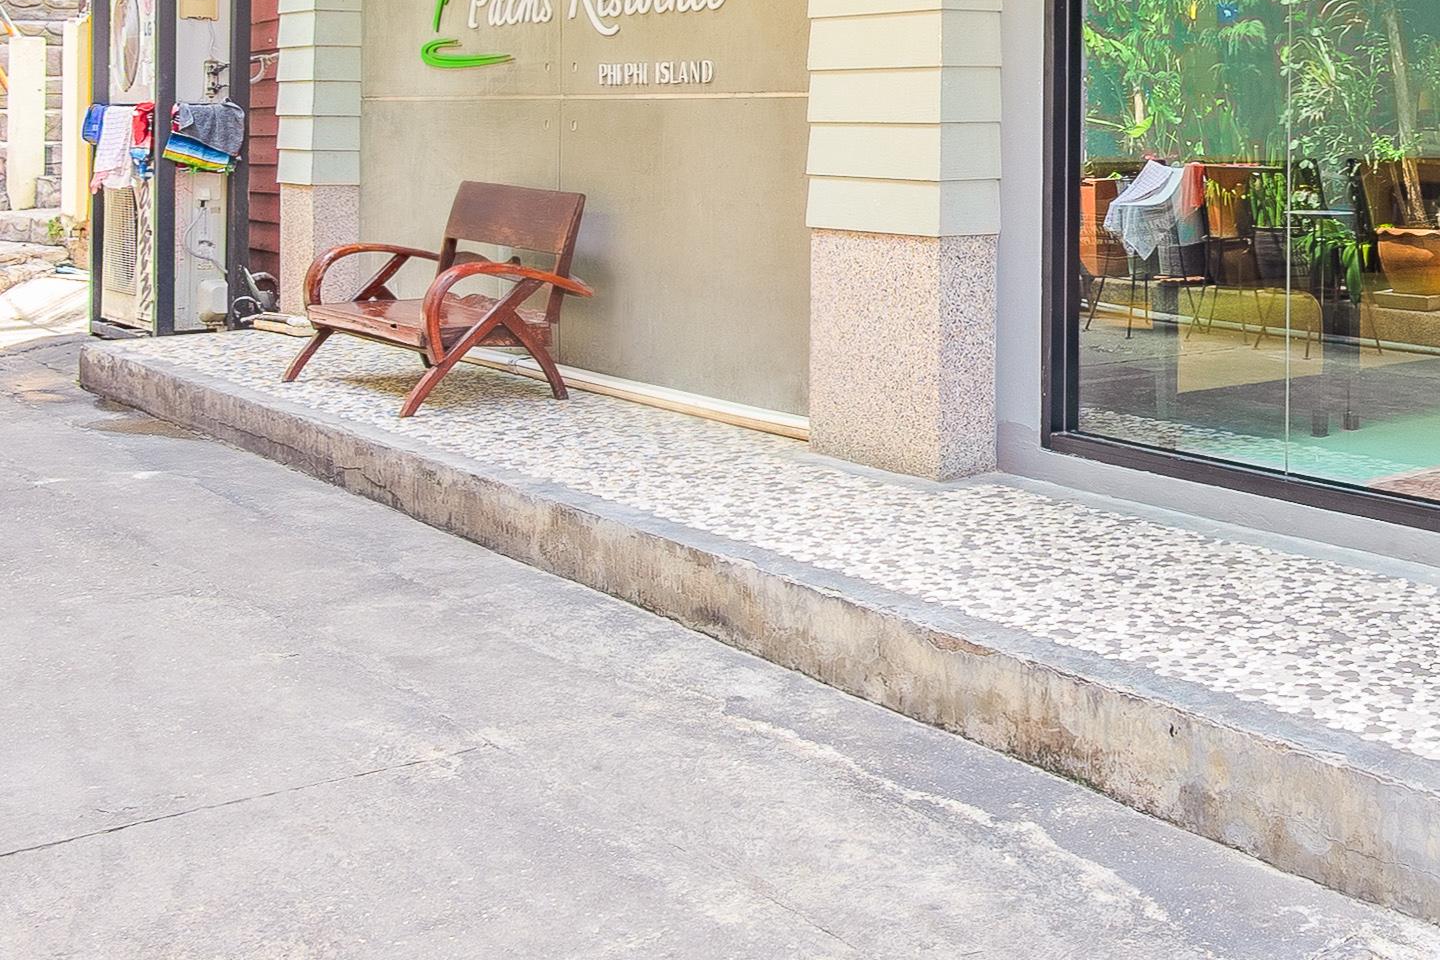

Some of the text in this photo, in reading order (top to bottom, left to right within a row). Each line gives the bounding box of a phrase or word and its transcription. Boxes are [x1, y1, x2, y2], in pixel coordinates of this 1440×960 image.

[599, 60, 715, 87] PHI PHI ISLAND
